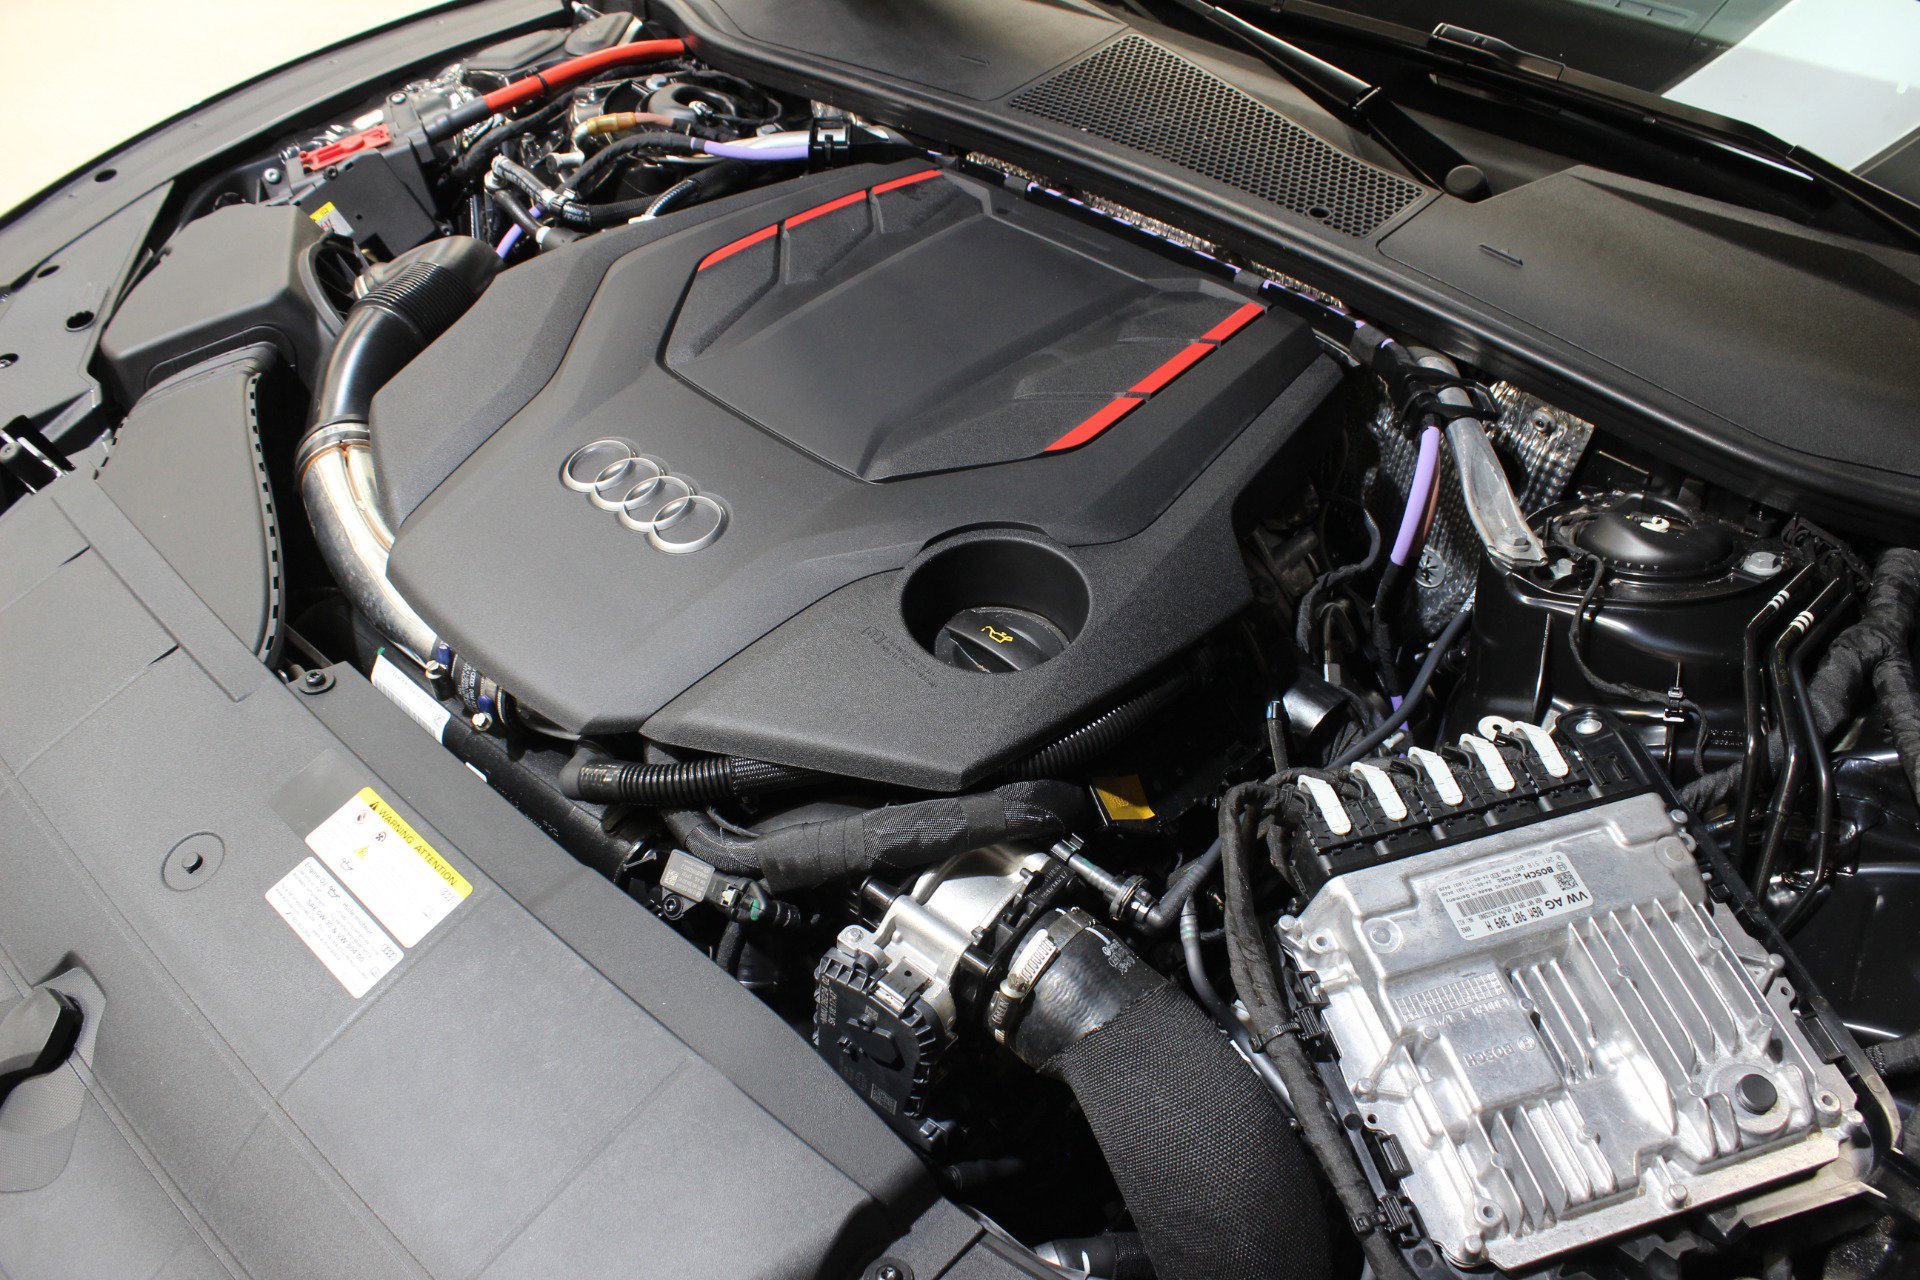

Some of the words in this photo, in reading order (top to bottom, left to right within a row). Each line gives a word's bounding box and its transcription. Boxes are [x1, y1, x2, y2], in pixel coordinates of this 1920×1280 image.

[377, 808, 415, 844] WARNING
[413, 843, 458, 886] ATTENTION
[1523, 866, 1554, 880] BOSCH
[1544, 897, 1563, 910] AG
[1565, 890, 1588, 904] VW
[1494, 915, 1510, 929] 309
[1511, 910, 1527, 923] 907
[1463, 1044, 1513, 1067] BOSCH
